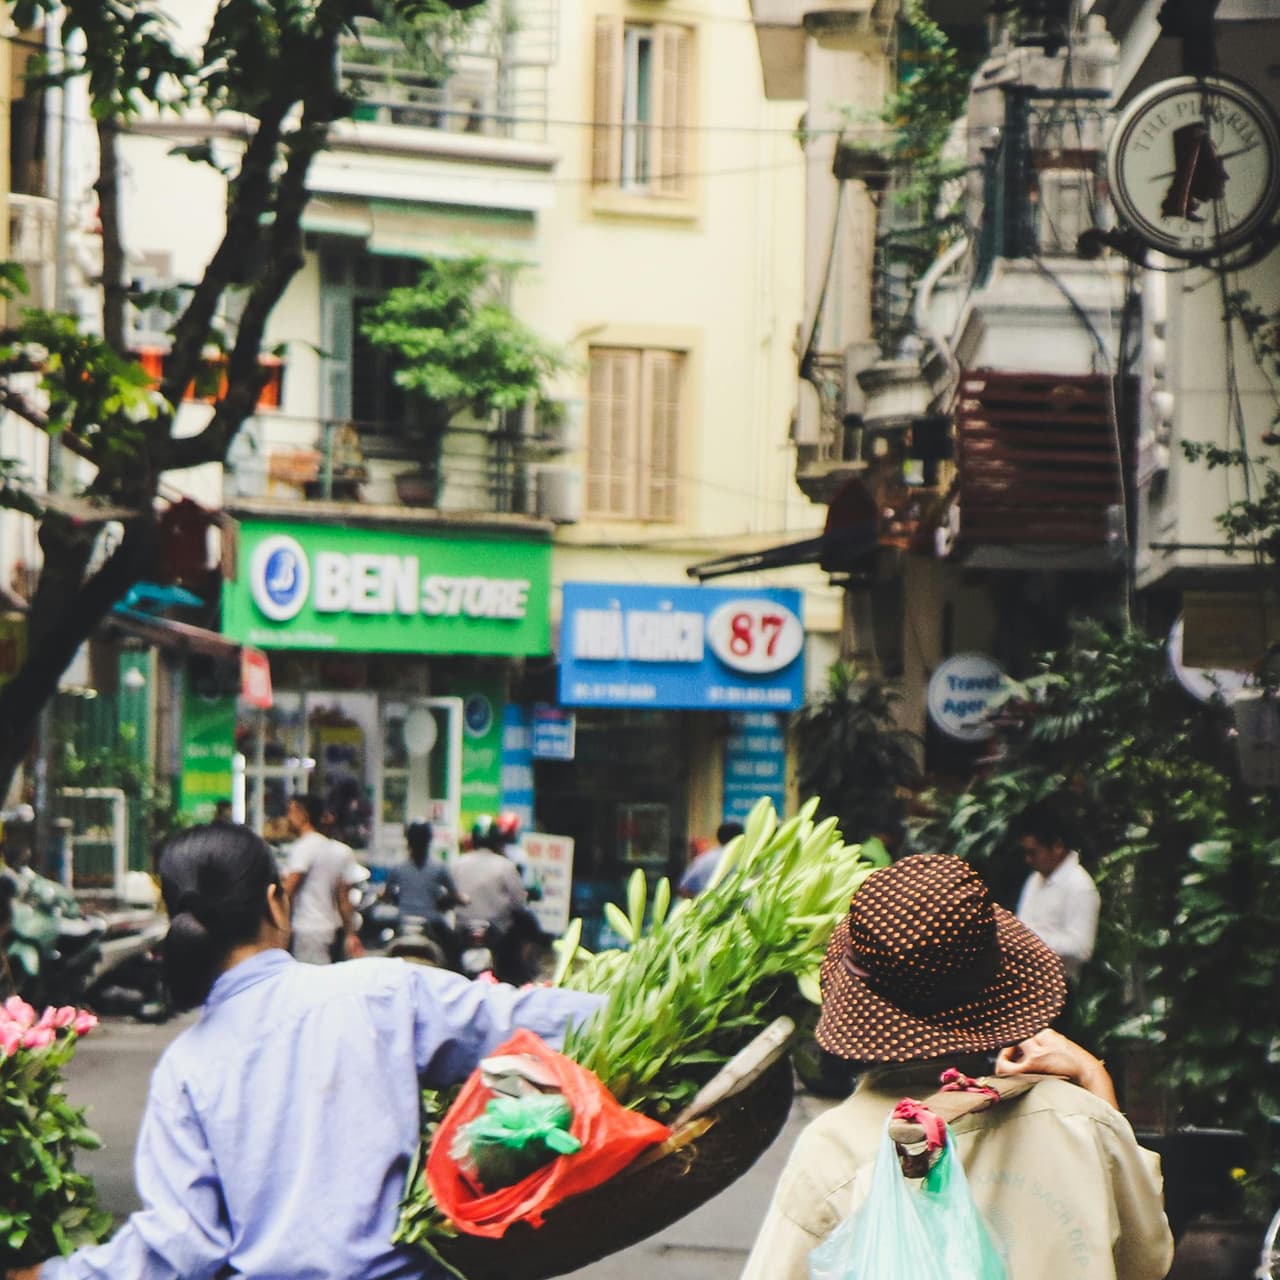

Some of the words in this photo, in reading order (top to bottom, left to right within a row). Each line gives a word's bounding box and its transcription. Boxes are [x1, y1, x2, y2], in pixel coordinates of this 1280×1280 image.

[1133, 111, 1171, 153] THE
[1176, 99, 1260, 147] PIGRIM
[313, 549, 420, 616] BEN
[421, 574, 531, 620] STORE
[729, 612, 786, 657] 87
[948, 674, 1001, 690] Travel
